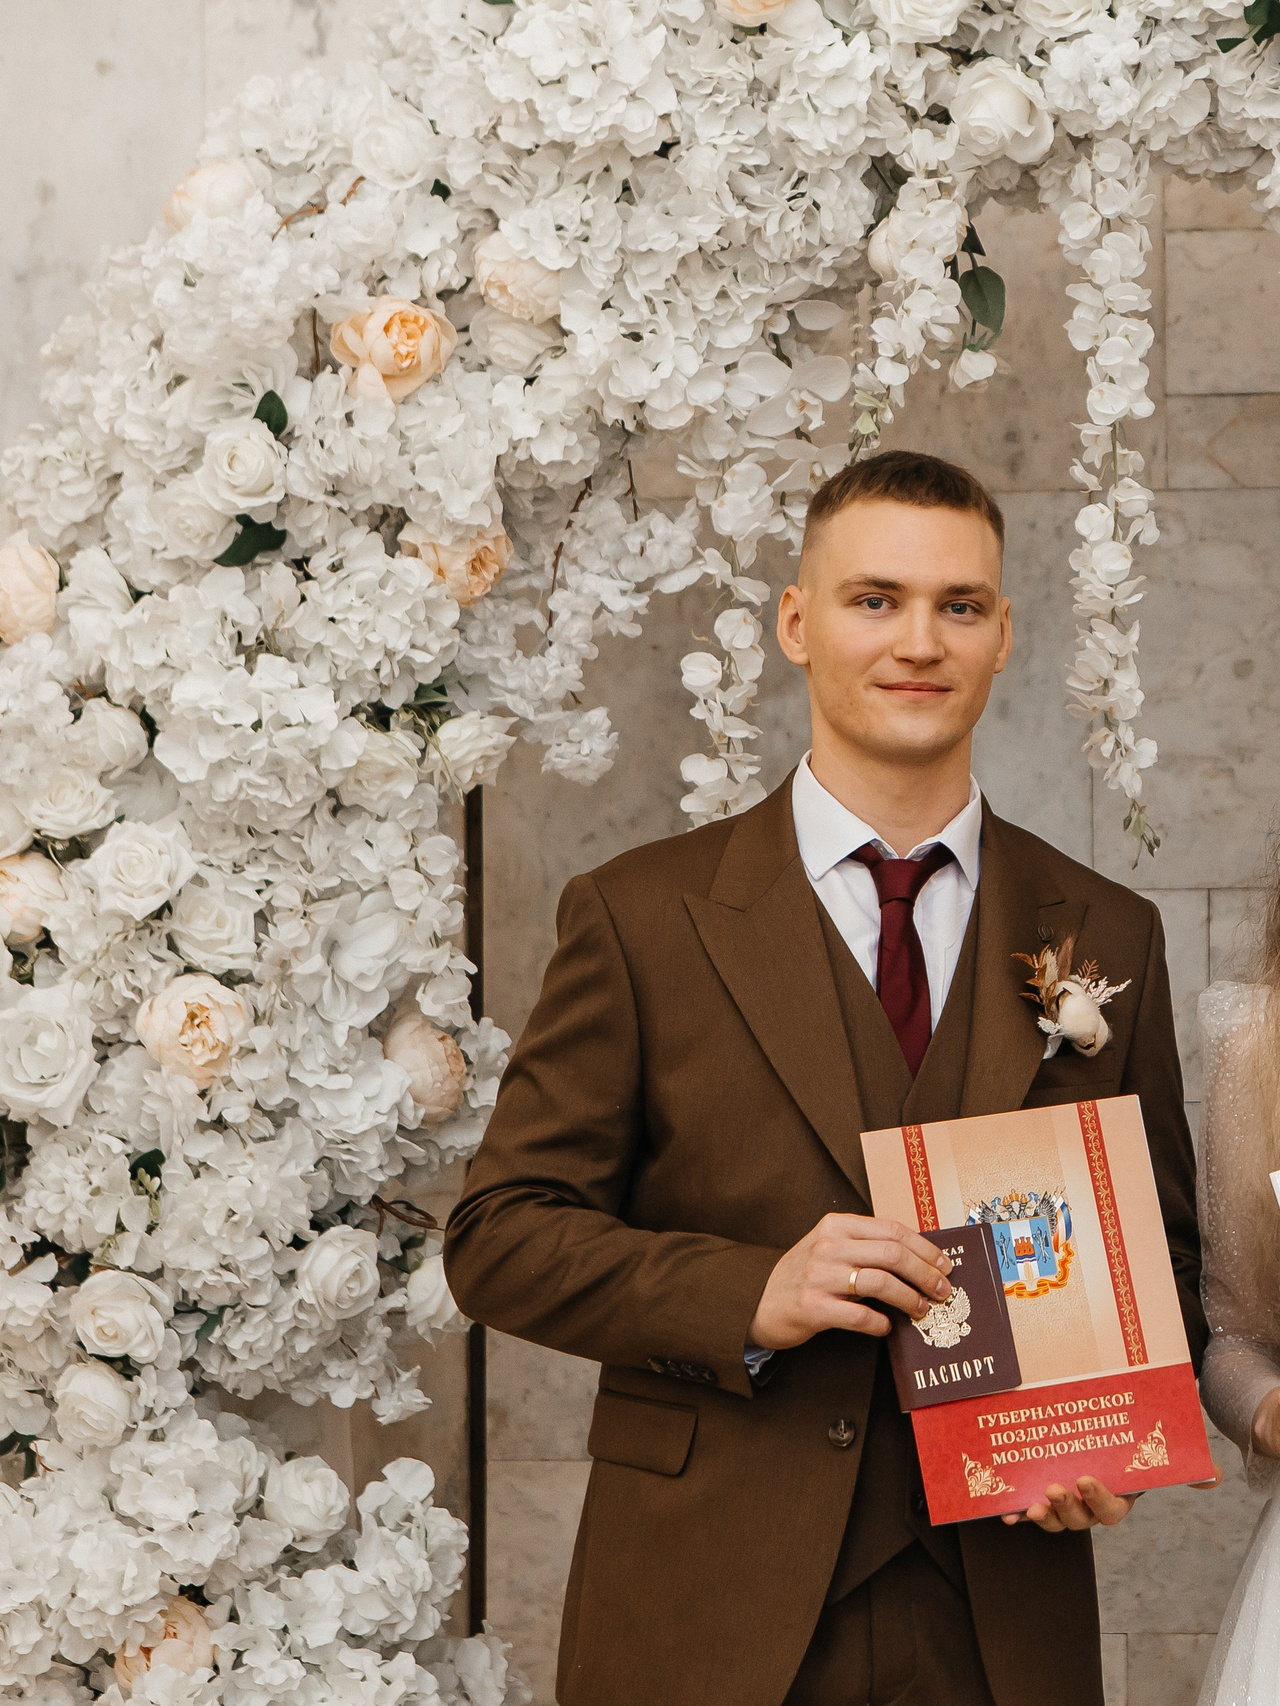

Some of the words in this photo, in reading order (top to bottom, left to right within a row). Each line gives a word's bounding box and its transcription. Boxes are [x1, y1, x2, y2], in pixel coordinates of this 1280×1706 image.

[914, 1355, 995, 1390] ПАСПОРТ
[977, 1391, 1135, 1429] ГУБЕРНАТОРСКОЕ
[990, 1411, 1130, 1447] ПОЗДРАВЛЕНИЕ
[991, 1430, 1135, 1466] МОЛОДОЖЁНАМ
